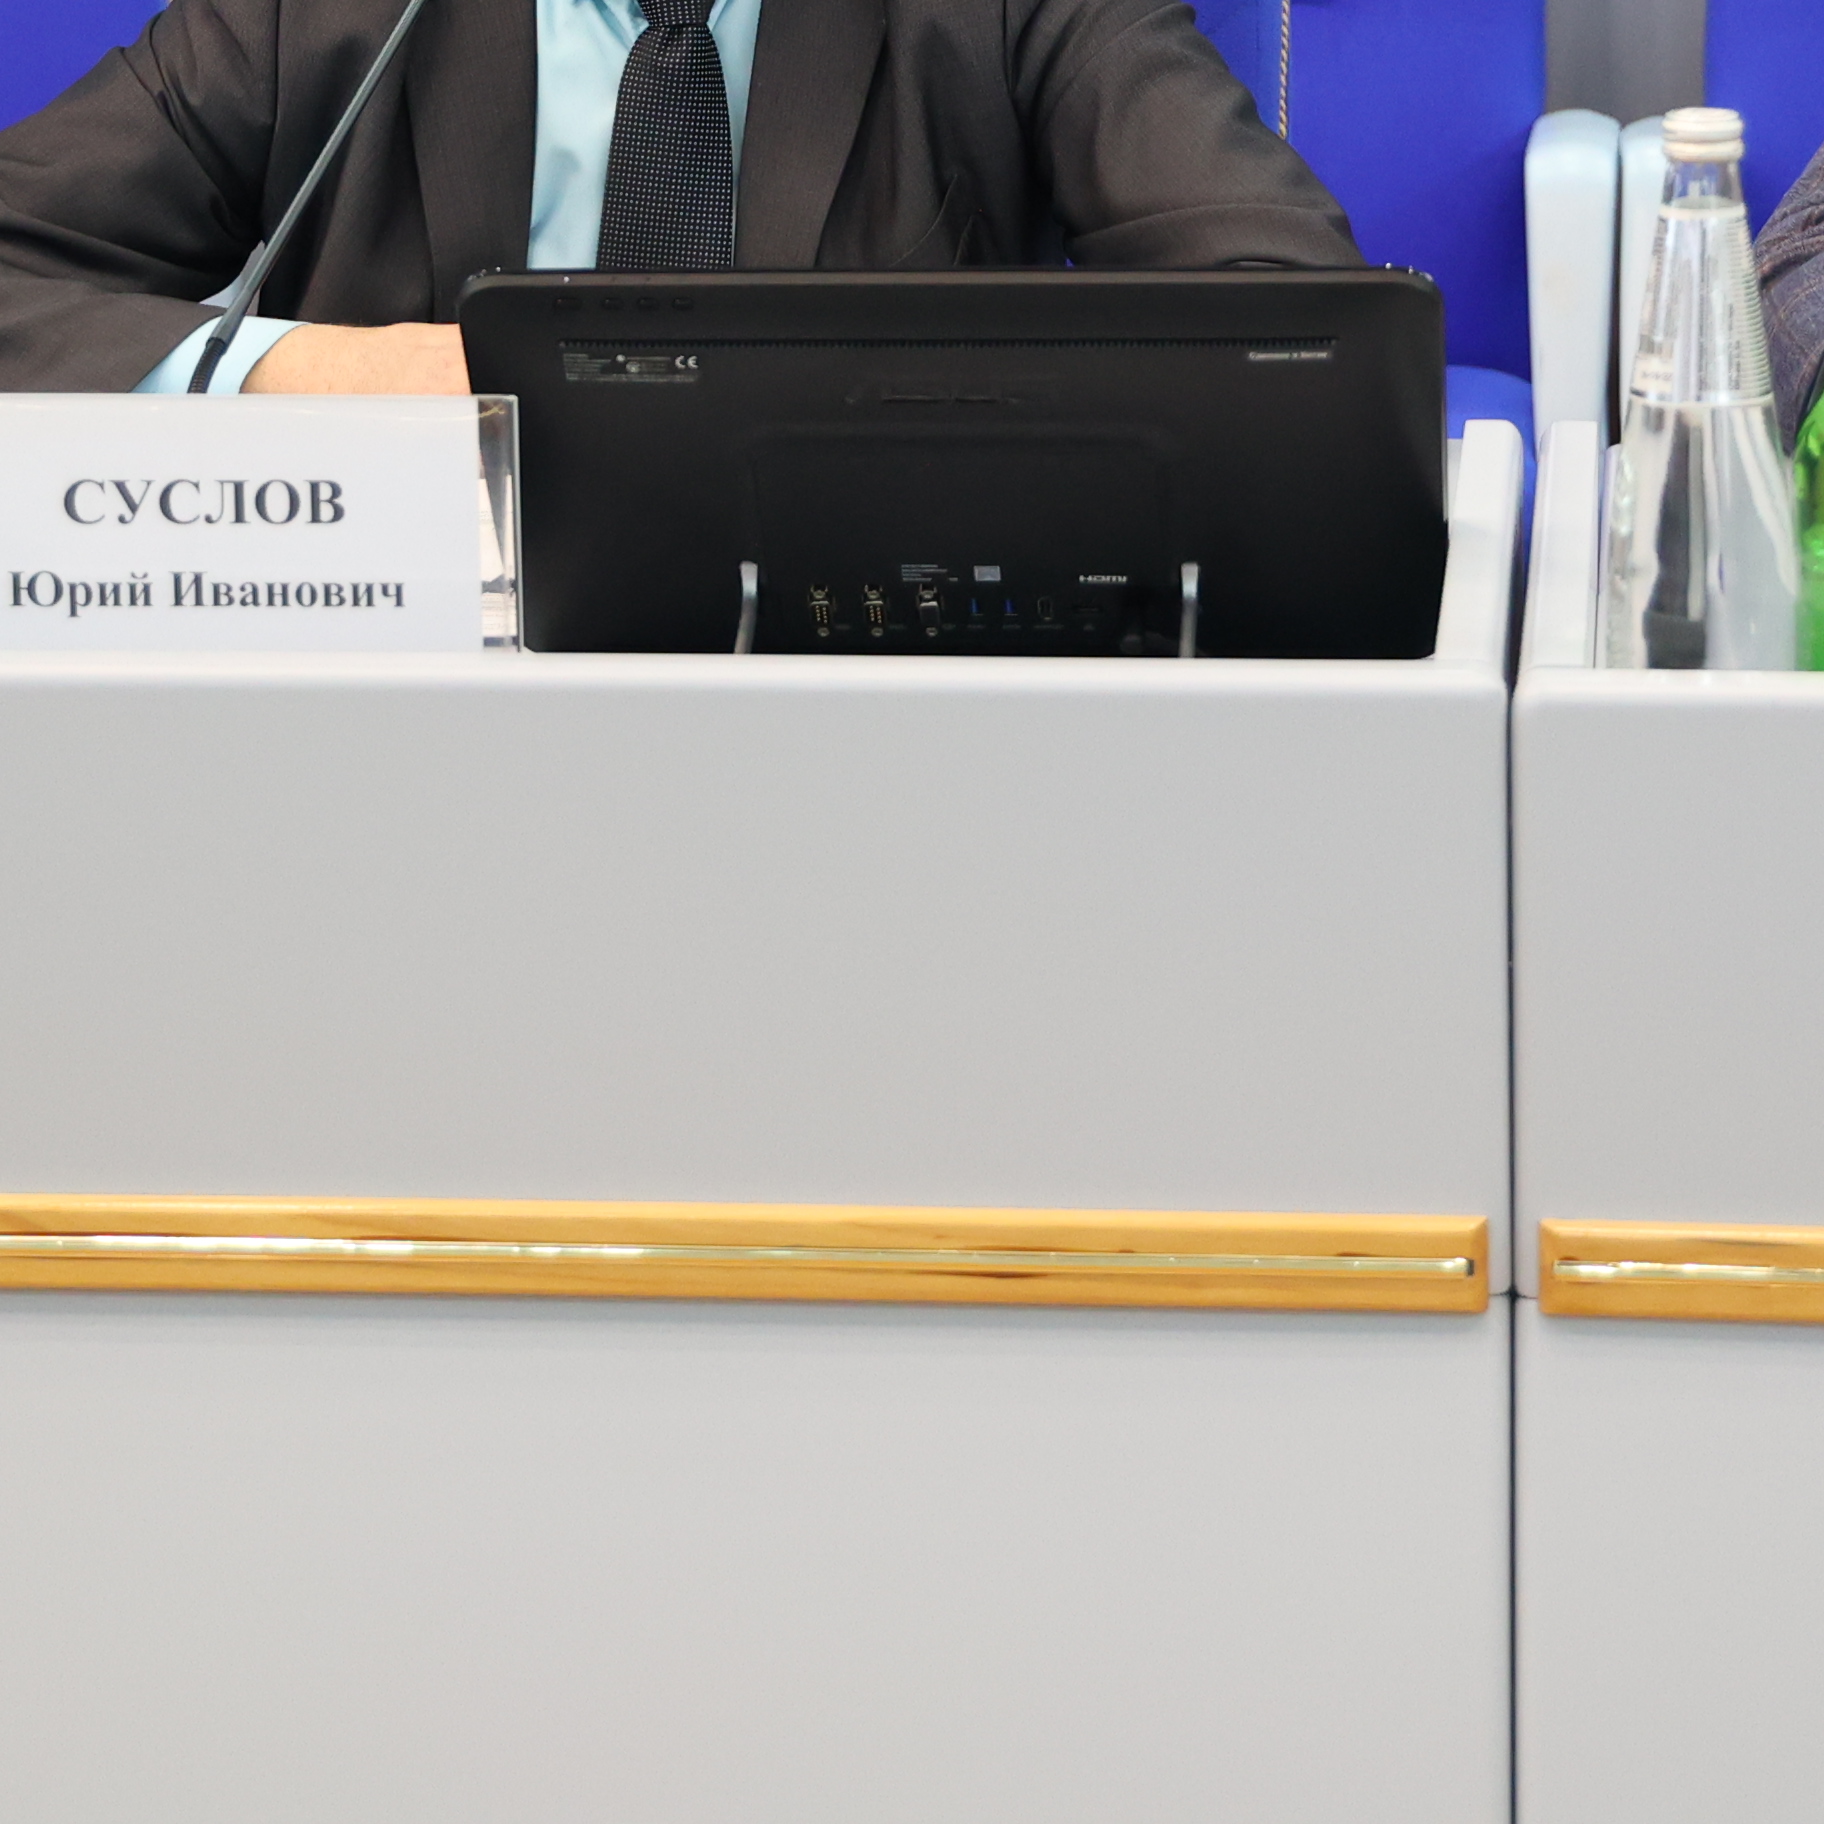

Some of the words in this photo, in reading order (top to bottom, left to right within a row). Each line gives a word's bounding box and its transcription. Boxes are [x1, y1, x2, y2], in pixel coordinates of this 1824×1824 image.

[62, 478, 346, 526] СУСЛОВ
[9, 569, 154, 618] Юрий
[170, 571, 406, 609] Иванович
